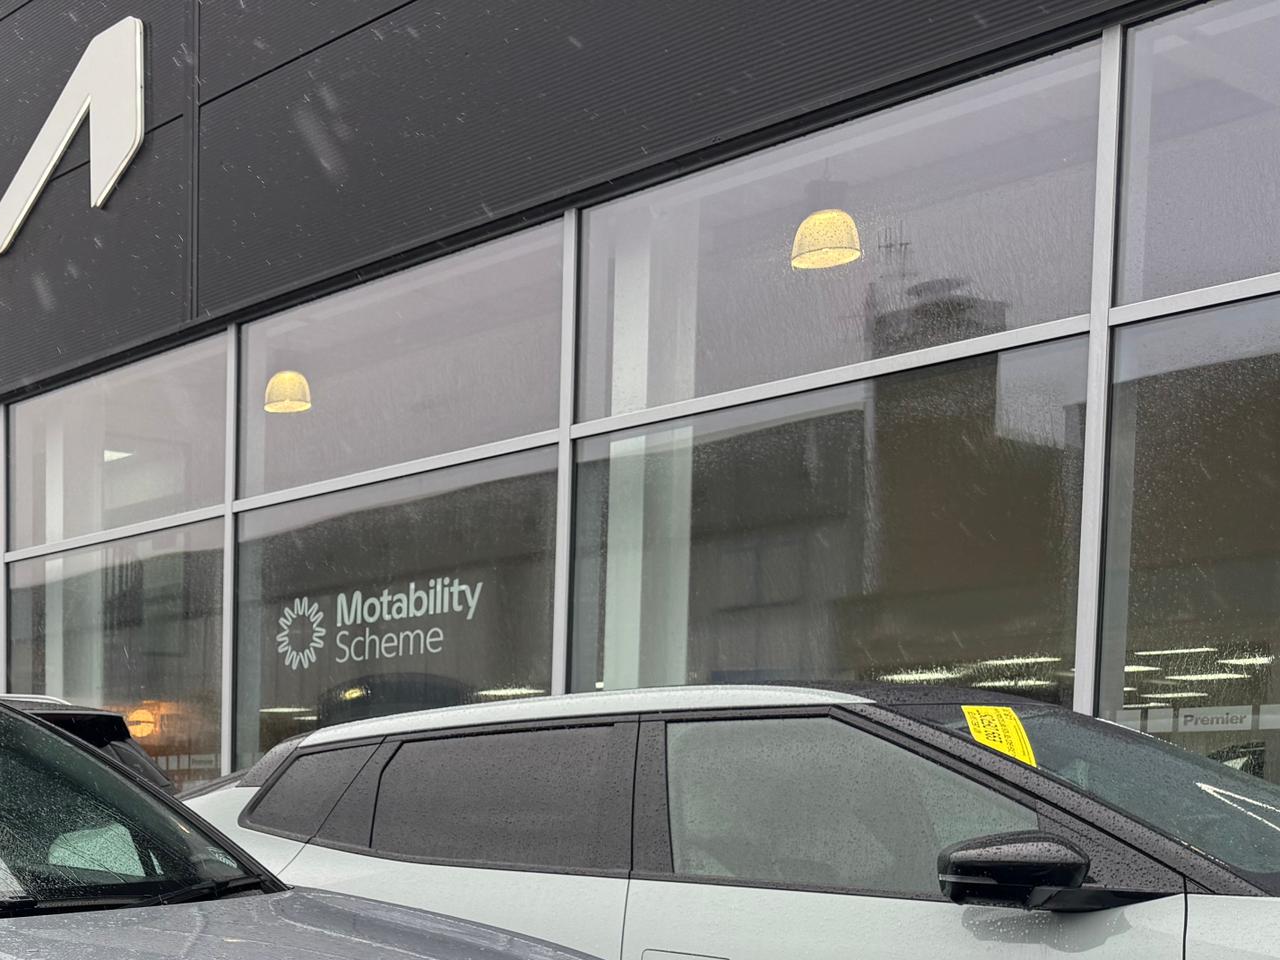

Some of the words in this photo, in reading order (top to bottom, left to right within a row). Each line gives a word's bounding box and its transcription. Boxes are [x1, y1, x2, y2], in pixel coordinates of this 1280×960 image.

[335, 576, 483, 627] Motability
[335, 627, 444, 663] Scheme
[1183, 712, 1247, 727] Premier
